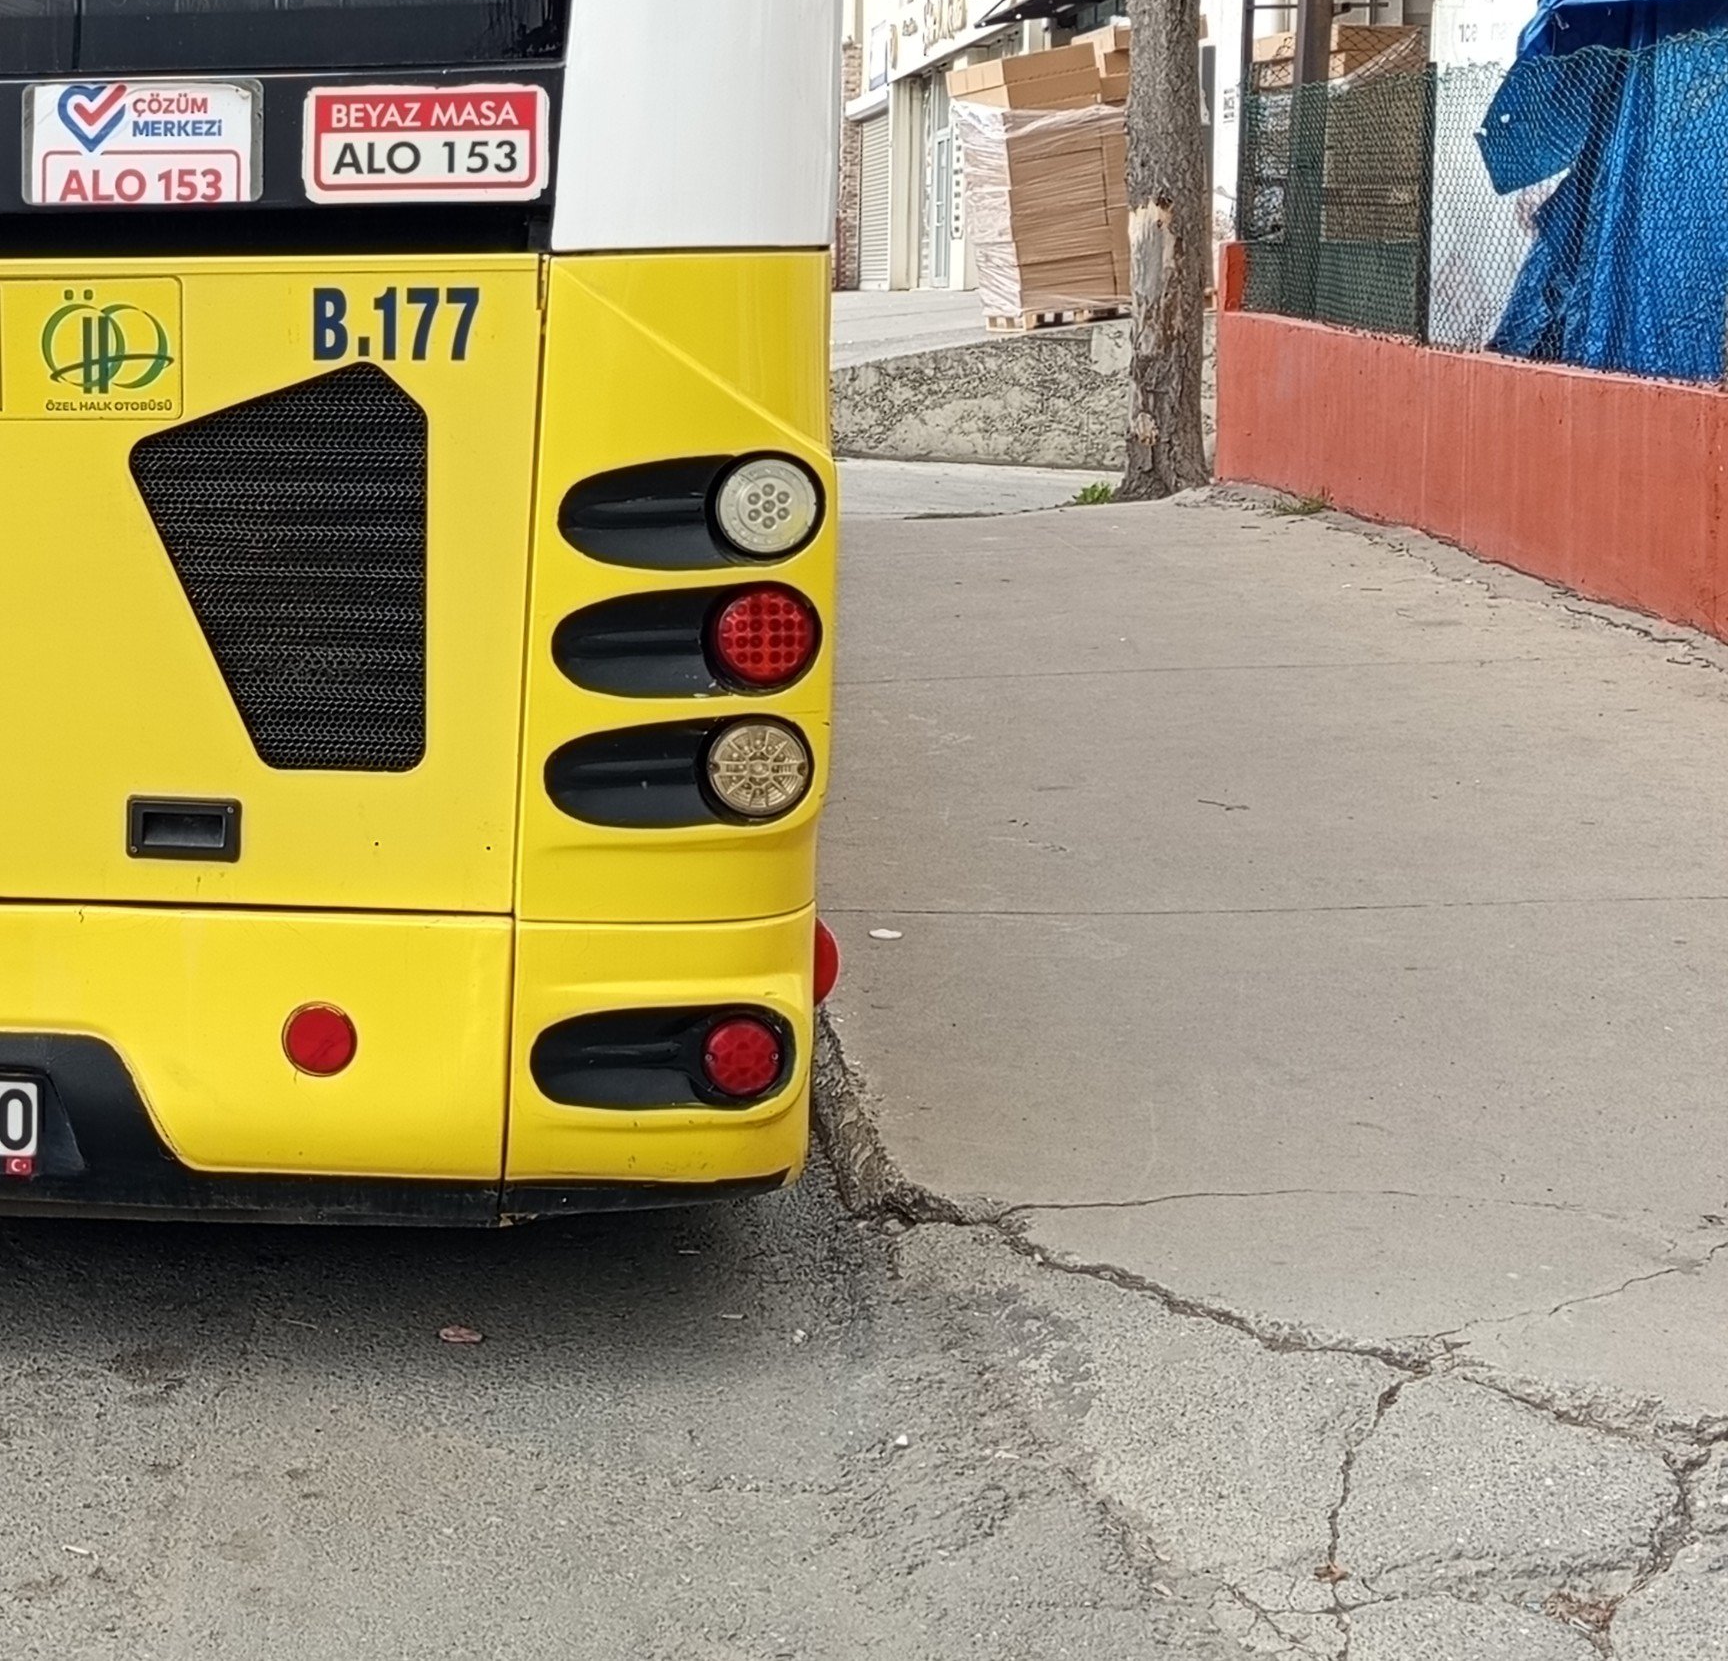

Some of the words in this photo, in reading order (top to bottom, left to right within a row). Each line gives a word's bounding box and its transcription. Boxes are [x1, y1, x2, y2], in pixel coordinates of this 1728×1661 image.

[131, 95, 209, 116] ÇÖZÜM
[331, 103, 421, 128] BEYAZ
[430, 100, 520, 125] MASA
[132, 118, 223, 138] MERKEZİ
[332, 142, 421, 175] ALO
[442, 140, 519, 173] 153
[60, 168, 146, 202] ALO
[157, 168, 223, 202] 153
[313, 287, 479, 361] B.177
[46, 400, 77, 411] ÖZEL
[80, 402, 112, 411] HALK
[115, 399, 172, 411] OTOBÜSÜ
